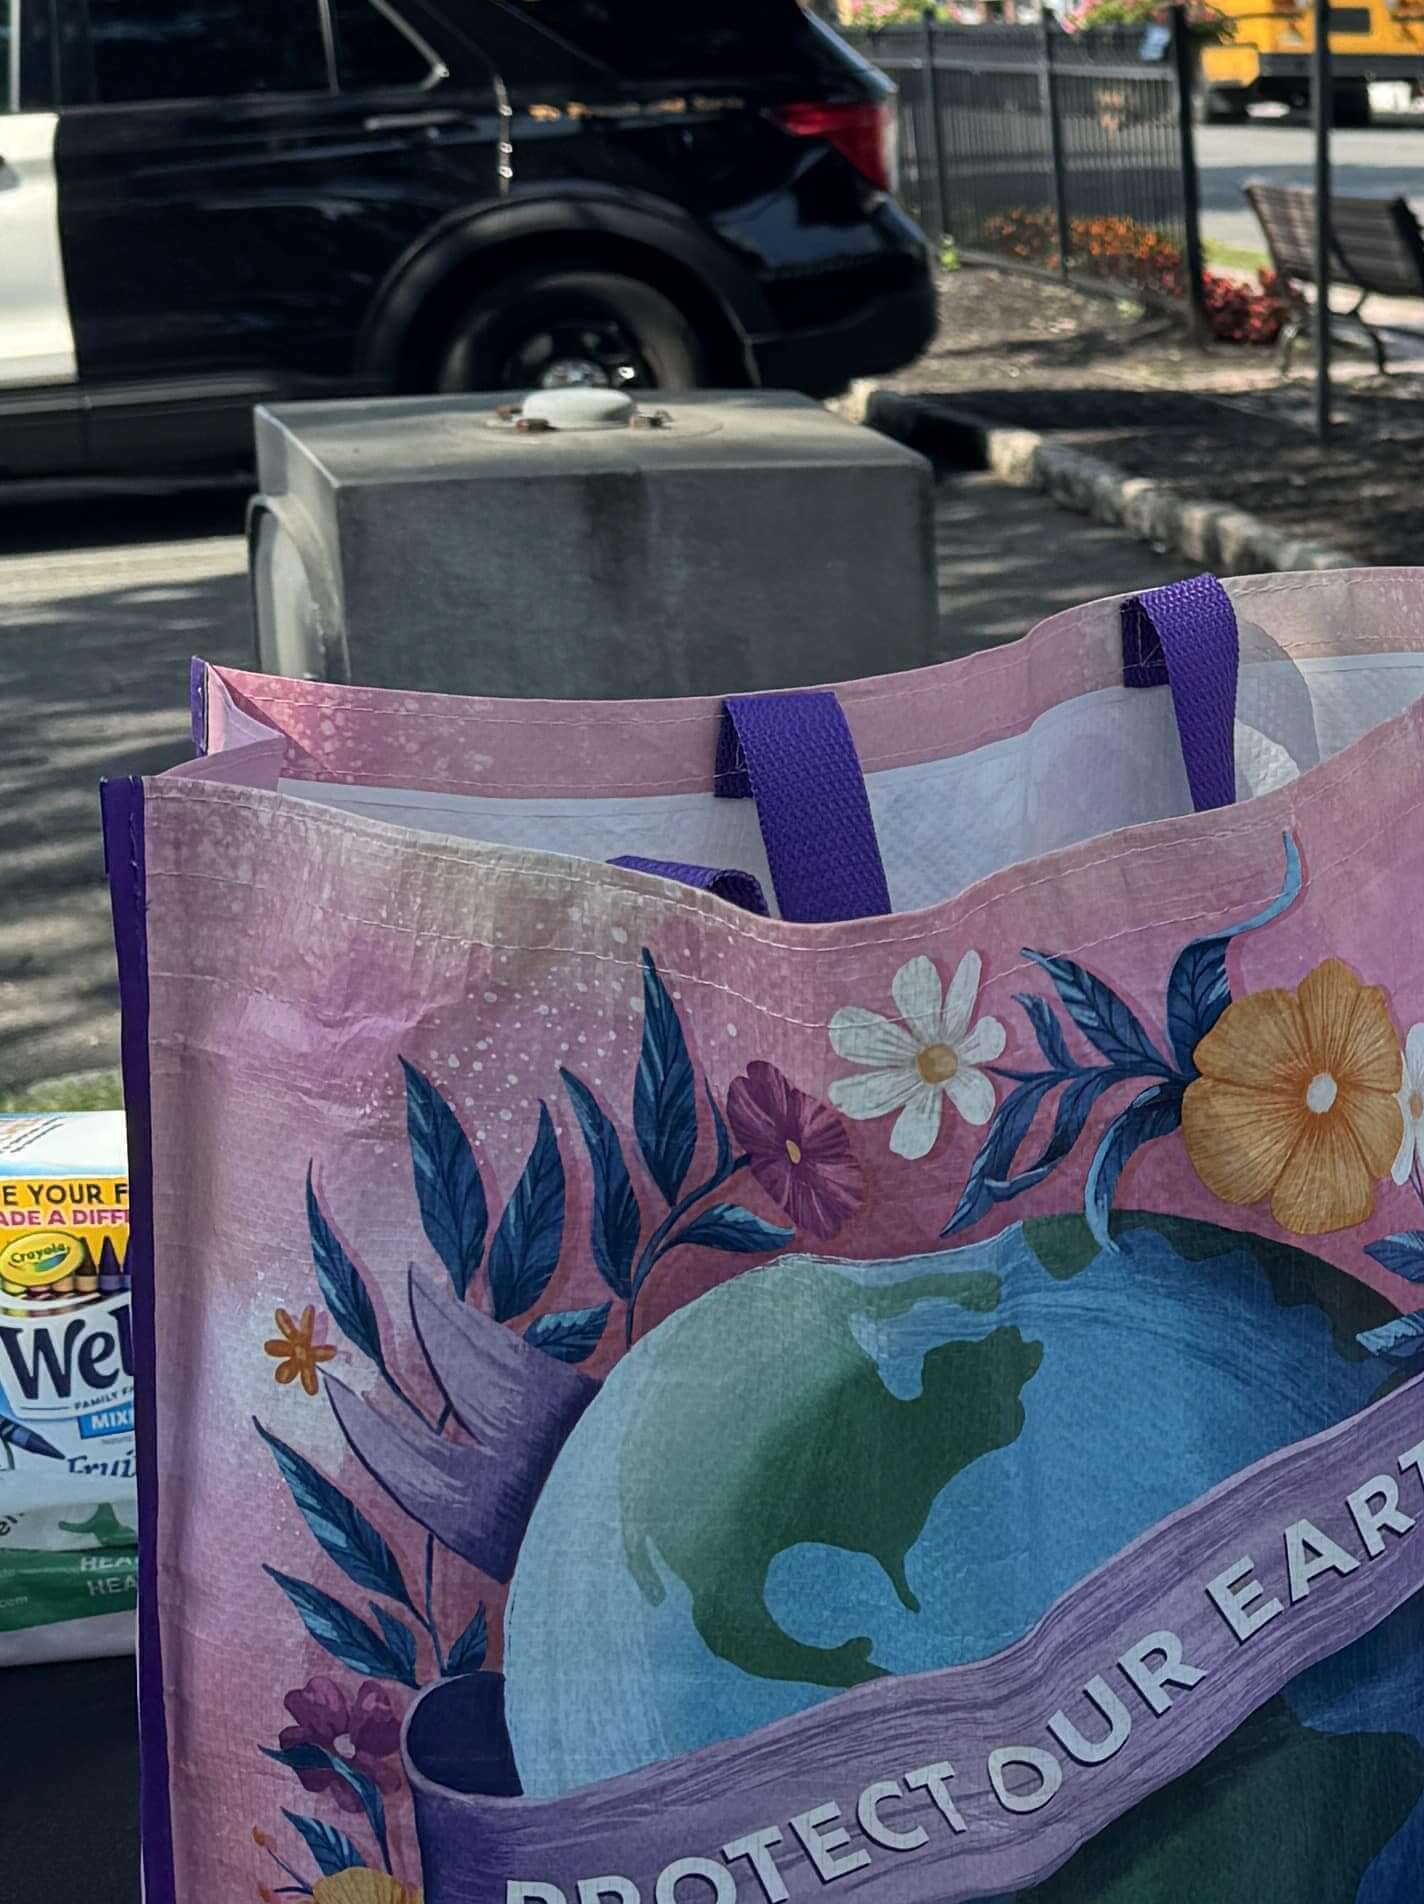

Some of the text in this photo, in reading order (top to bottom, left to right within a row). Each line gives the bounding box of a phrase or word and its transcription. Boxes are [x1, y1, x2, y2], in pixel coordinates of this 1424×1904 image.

[27, 1184, 104, 1205] YOUR
[48, 1210, 66, 1225] A
[72, 1209, 129, 1225] DIFF
[10, 1242, 66, 1265] Crayola
[74, 1392, 118, 1410] FAMILY
[986, 1628, 1207, 1814] OUR
